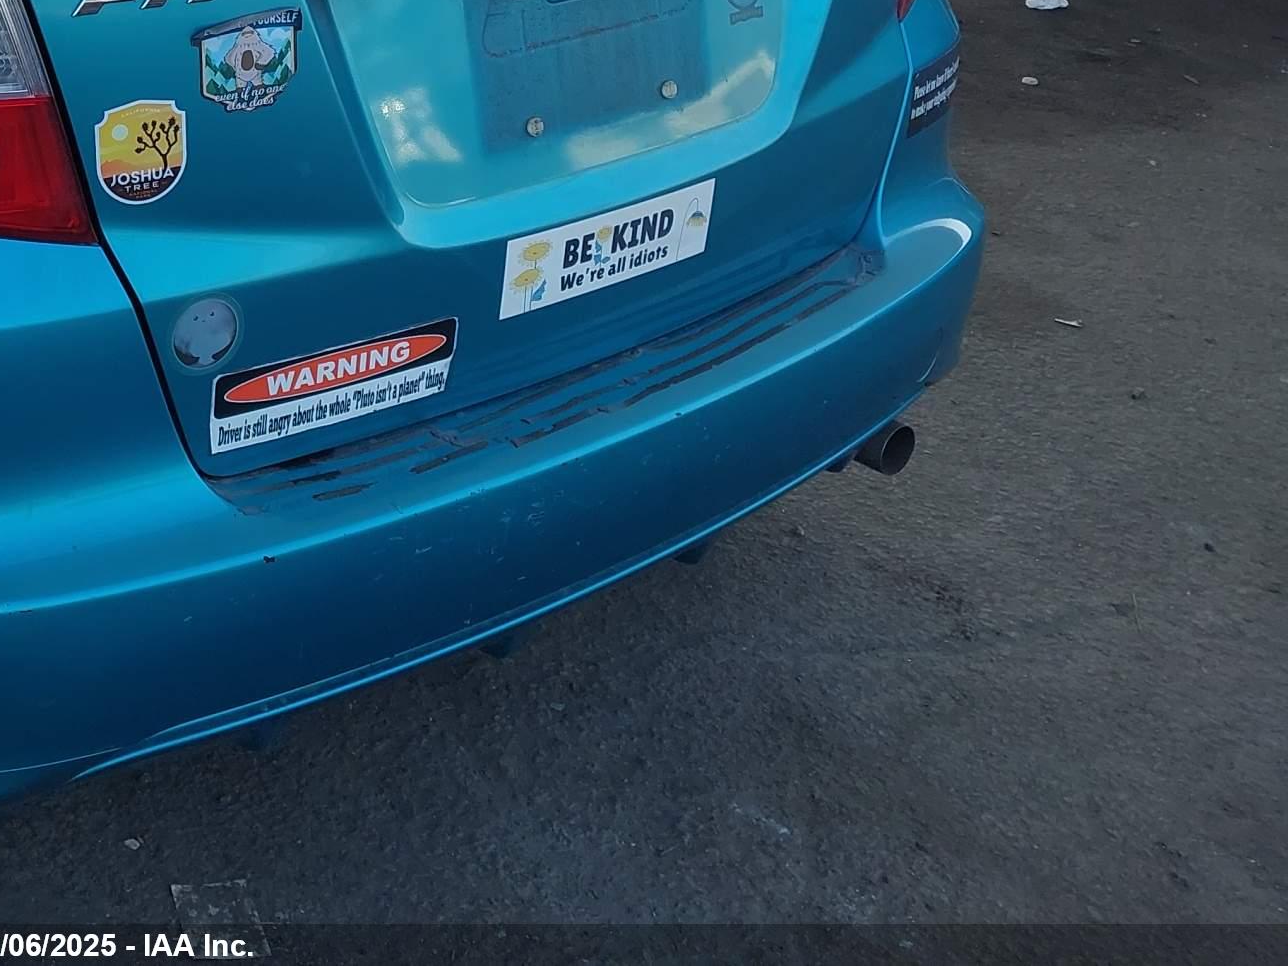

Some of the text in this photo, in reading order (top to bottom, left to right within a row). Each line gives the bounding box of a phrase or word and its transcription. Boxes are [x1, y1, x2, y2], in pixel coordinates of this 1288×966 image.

[215, 93, 239, 103] even
[241, 87, 250, 101] if
[252, 87, 265, 95] no
[226, 96, 274, 112] else does
[110, 167, 175, 187] JOSHUA
[124, 180, 160, 193] TREE
[562, 208, 675, 269] BE KIND
[560, 244, 668, 292] We're all idiots
[266, 341, 410, 396] WARNING
[217, 424, 243, 447] Driver
[243, 422, 251, 440] is
[252, 414, 268, 438] still
[268, 413, 291, 438] angry
[292, 405, 314, 428] about
[315, 401, 328, 422] the
[328, 395, 352, 417] whole
[375, 381, 393, 404] isn't
[392, 385, 397, 399] a
[425, 368, 446, 397] thing.
